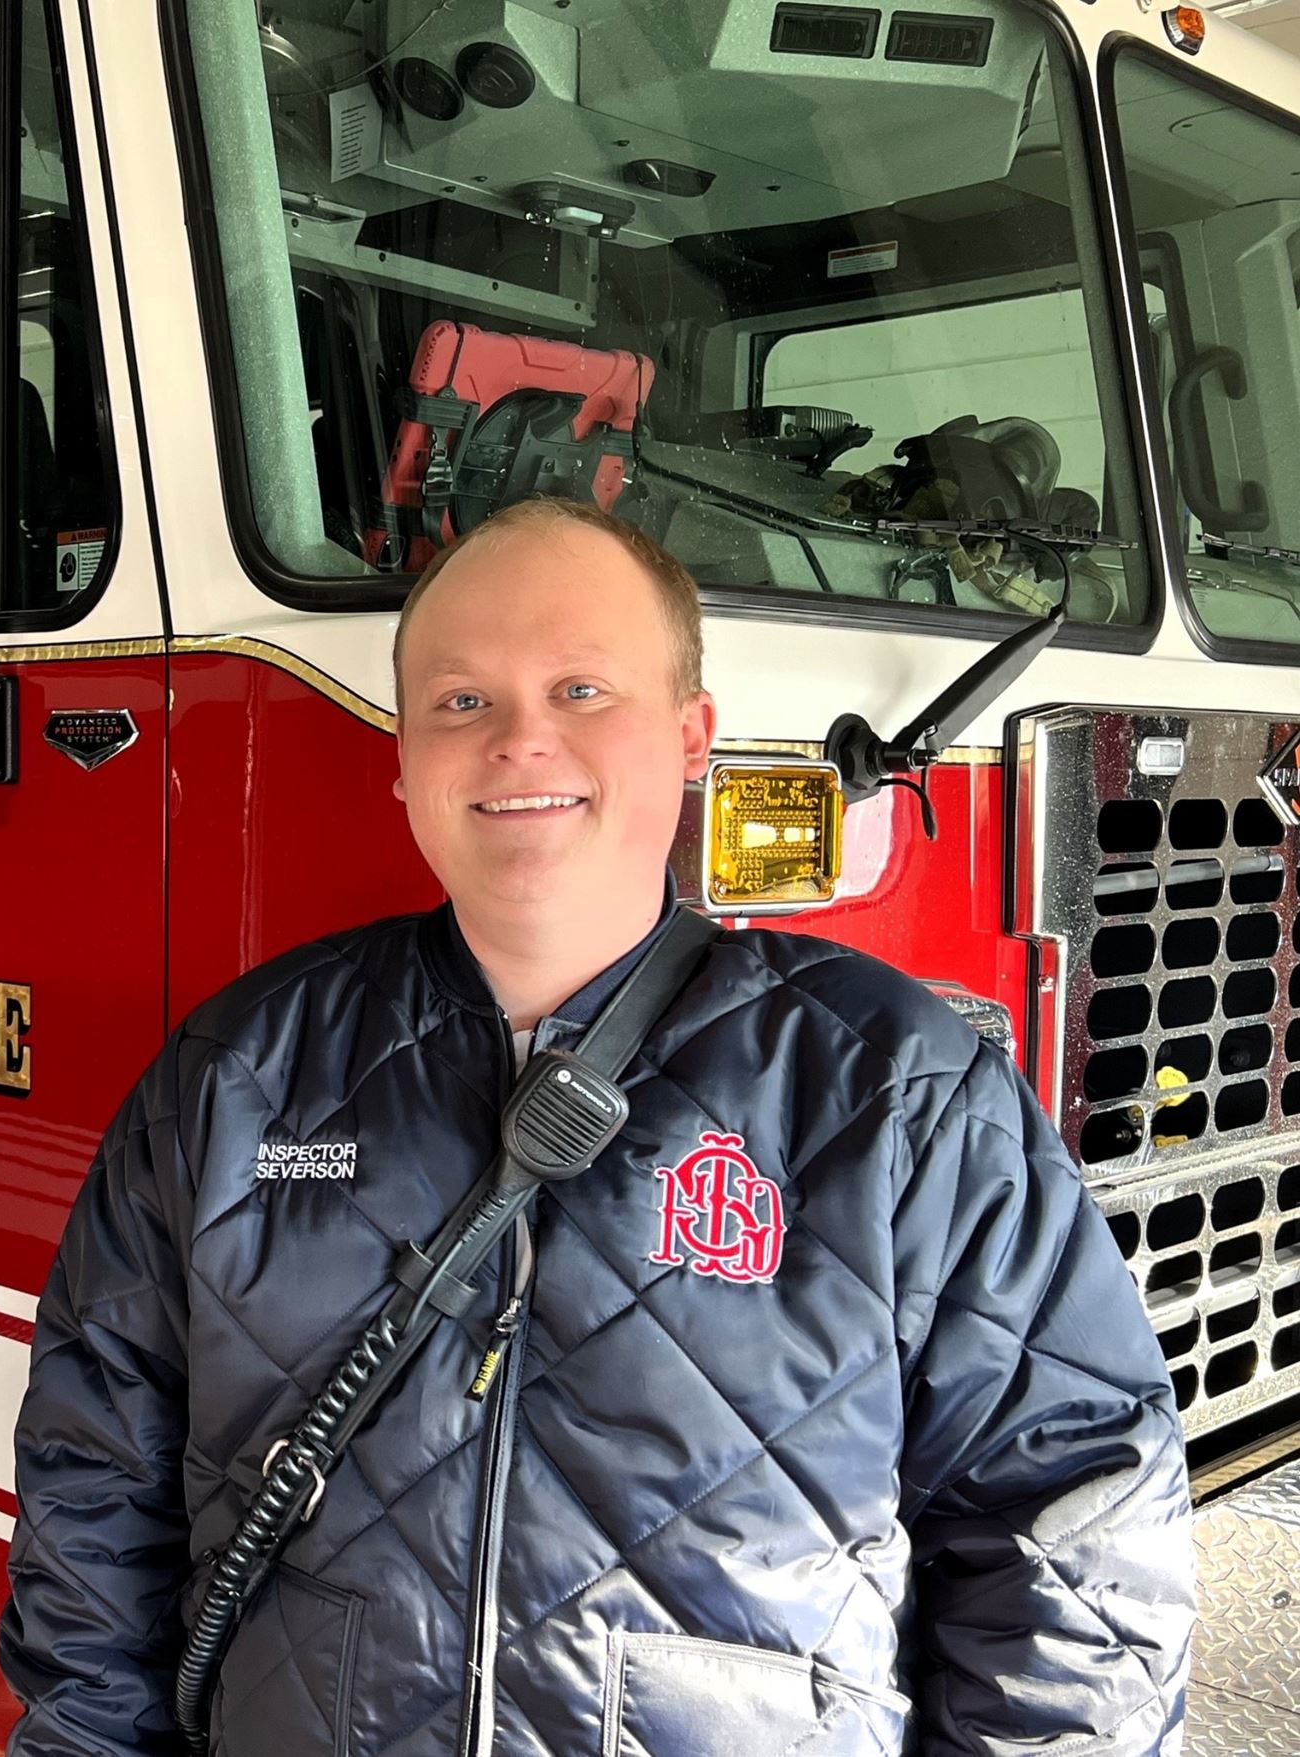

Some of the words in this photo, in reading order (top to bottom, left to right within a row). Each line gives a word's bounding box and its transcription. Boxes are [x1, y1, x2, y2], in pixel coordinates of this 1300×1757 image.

[54, 726, 122, 735] PROTECTION
[60, 718, 118, 726] ADVANCED
[67, 735, 110, 743] SYSTEM
[1274, 767, 1300, 787] SPA
[570, 1080, 612, 1113] MOTOROLA
[257, 1142, 358, 1161] INSPECTOR
[255, 1160, 356, 1179] SEVERSON
[478, 1350, 500, 1380] GAME
